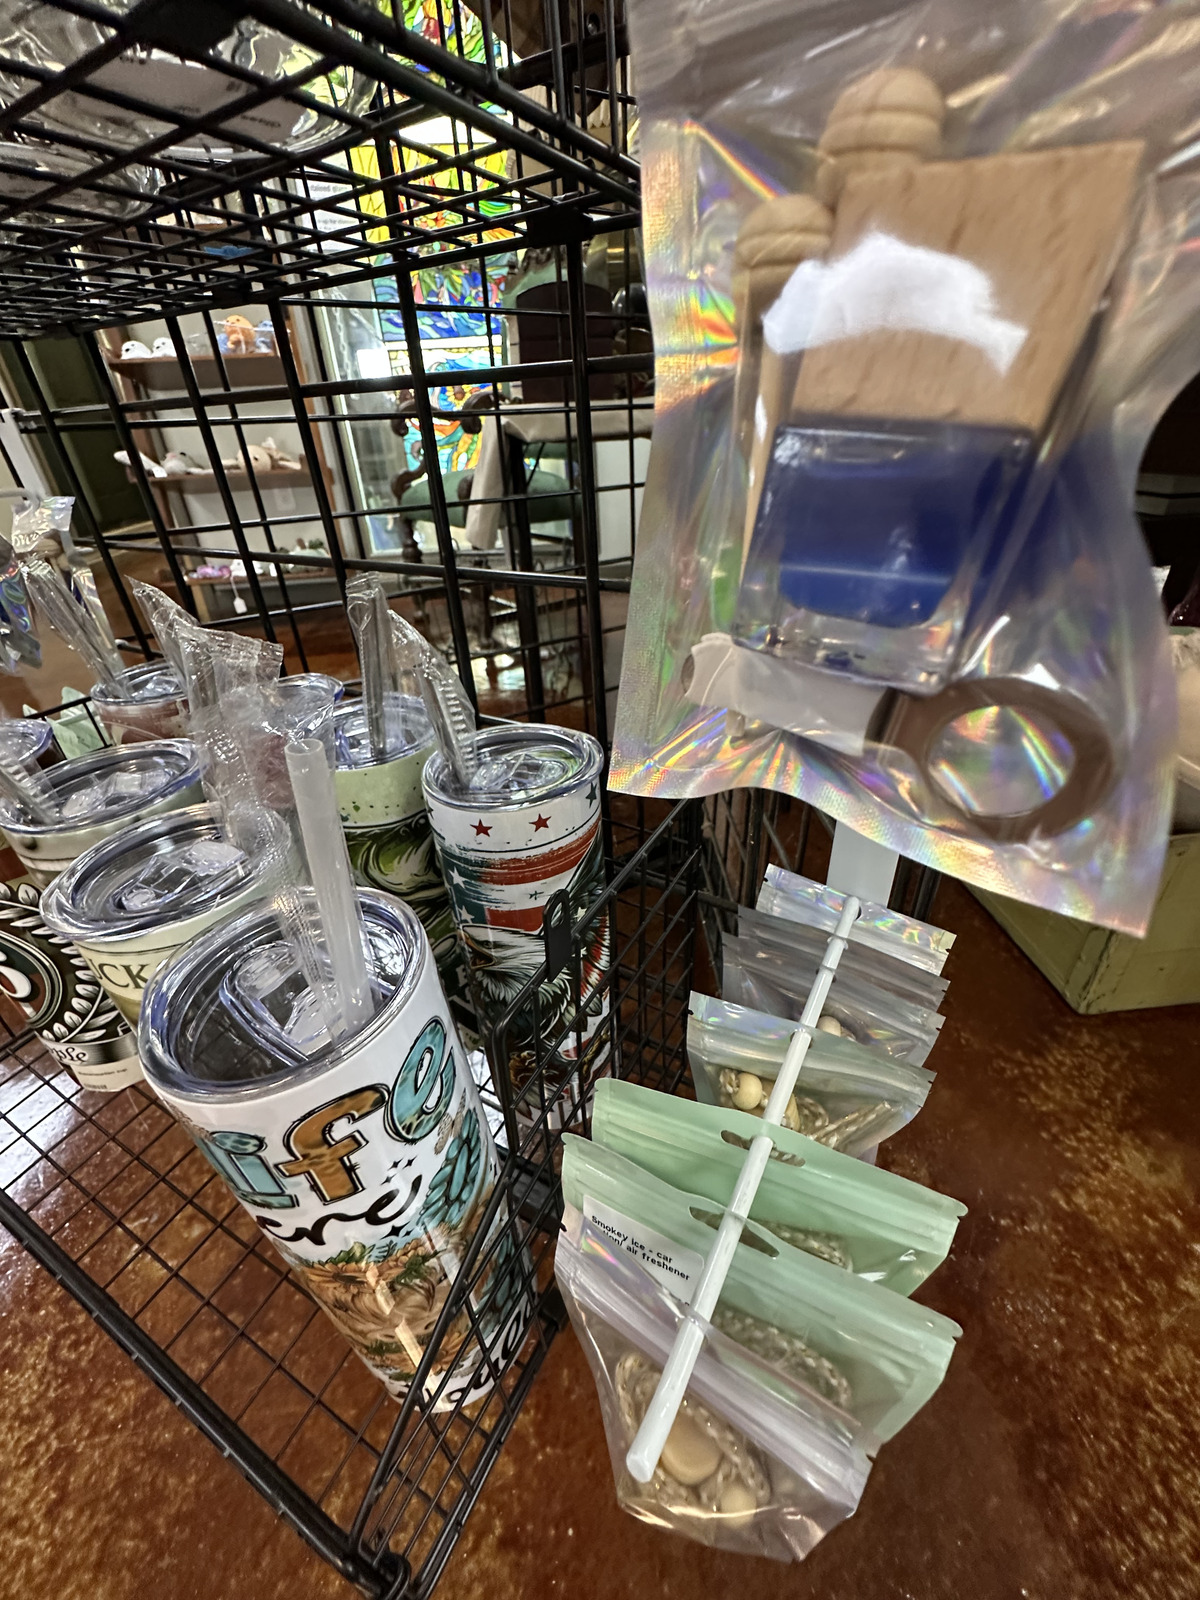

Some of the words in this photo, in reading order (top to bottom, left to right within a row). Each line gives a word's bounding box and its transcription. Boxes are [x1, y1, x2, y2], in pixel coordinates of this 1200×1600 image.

[591, 1215, 628, 1241] Smokey
[656, 1251, 674, 1264] car
[626, 1245, 639, 1256] air
[642, 1253, 690, 1281] freshener
